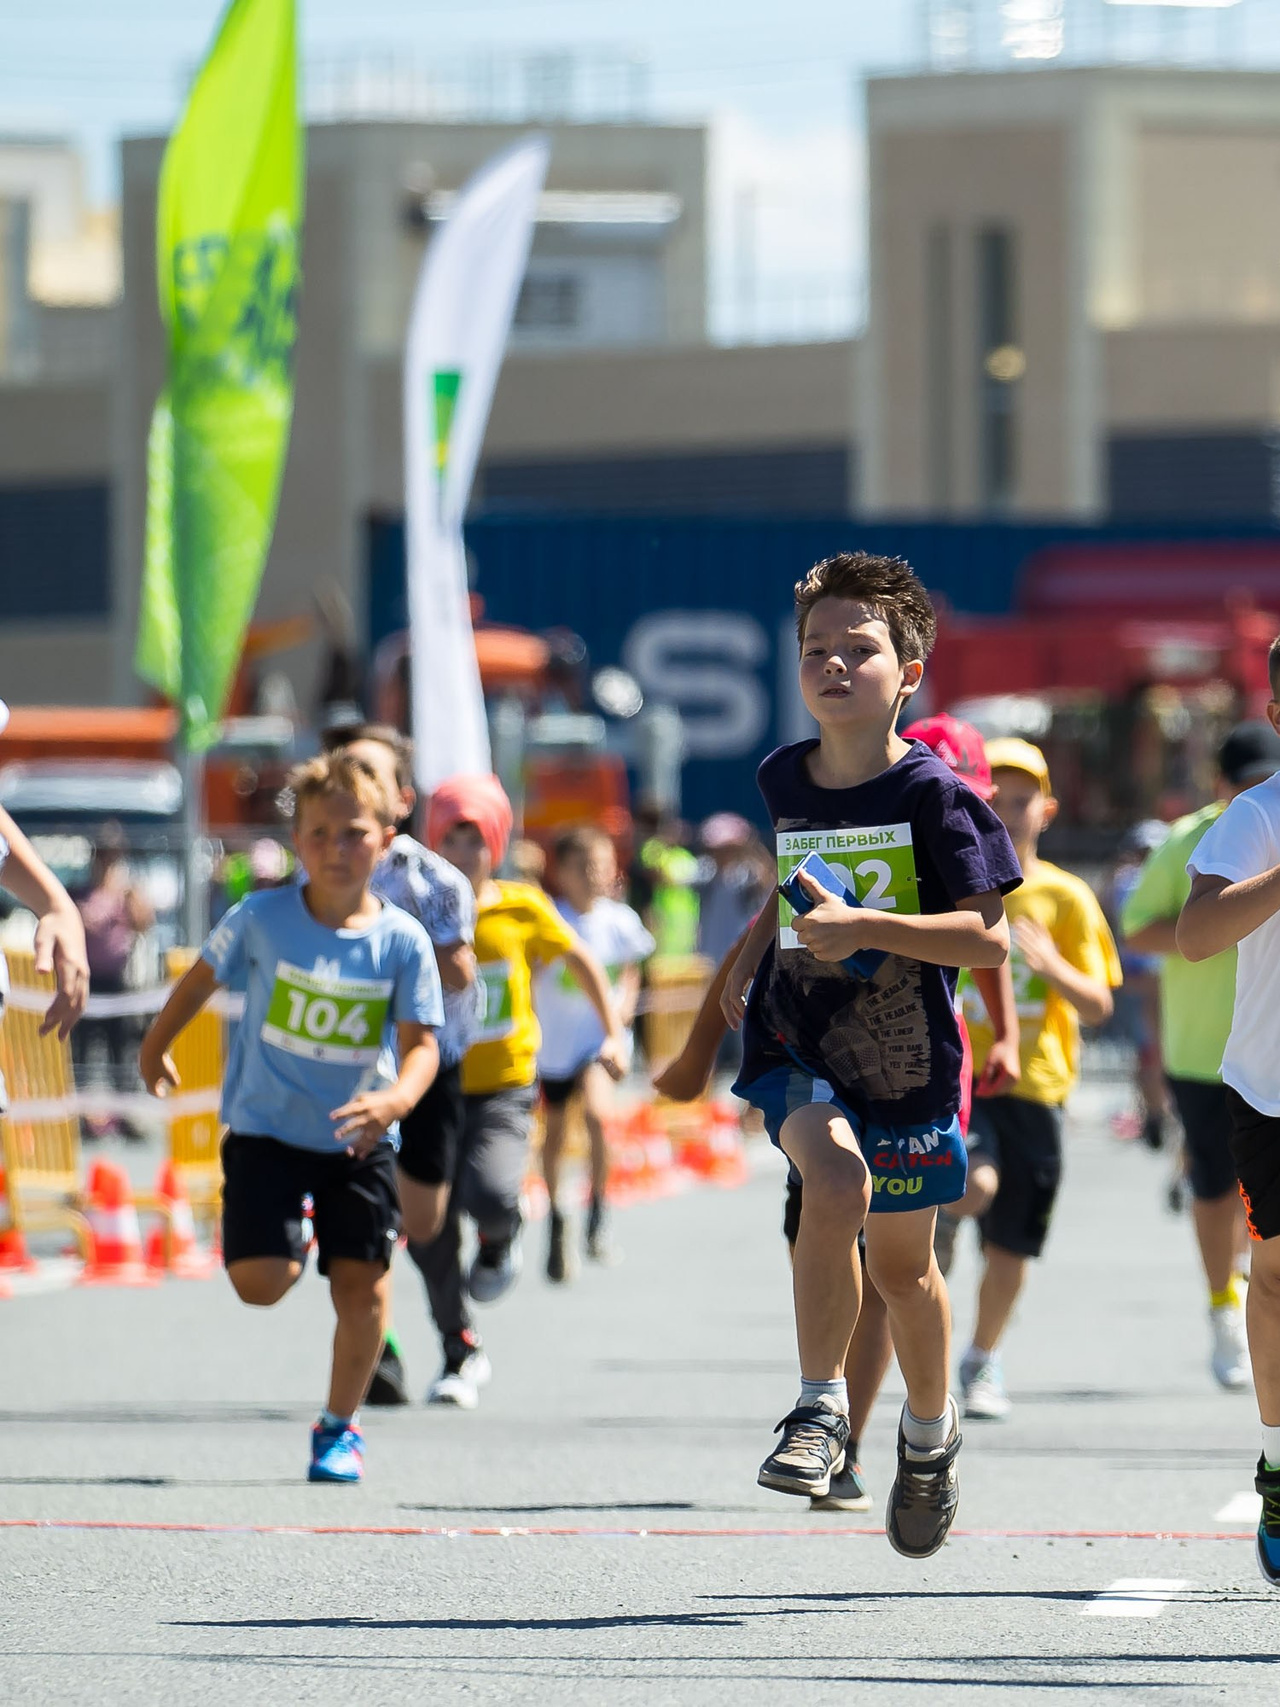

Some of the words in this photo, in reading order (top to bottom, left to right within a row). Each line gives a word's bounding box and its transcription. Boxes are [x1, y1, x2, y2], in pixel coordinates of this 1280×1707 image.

[785, 837, 822, 851] ЗАБЕГ
[826, 831, 896, 849] ПЕРВЫХ
[286, 989, 370, 1044] 104
[868, 1014, 883, 1026] THE
[884, 1002, 919, 1021] HEADLINE
[880, 1028, 892, 1039] THE
[872, 1174, 923, 1195] YOU
